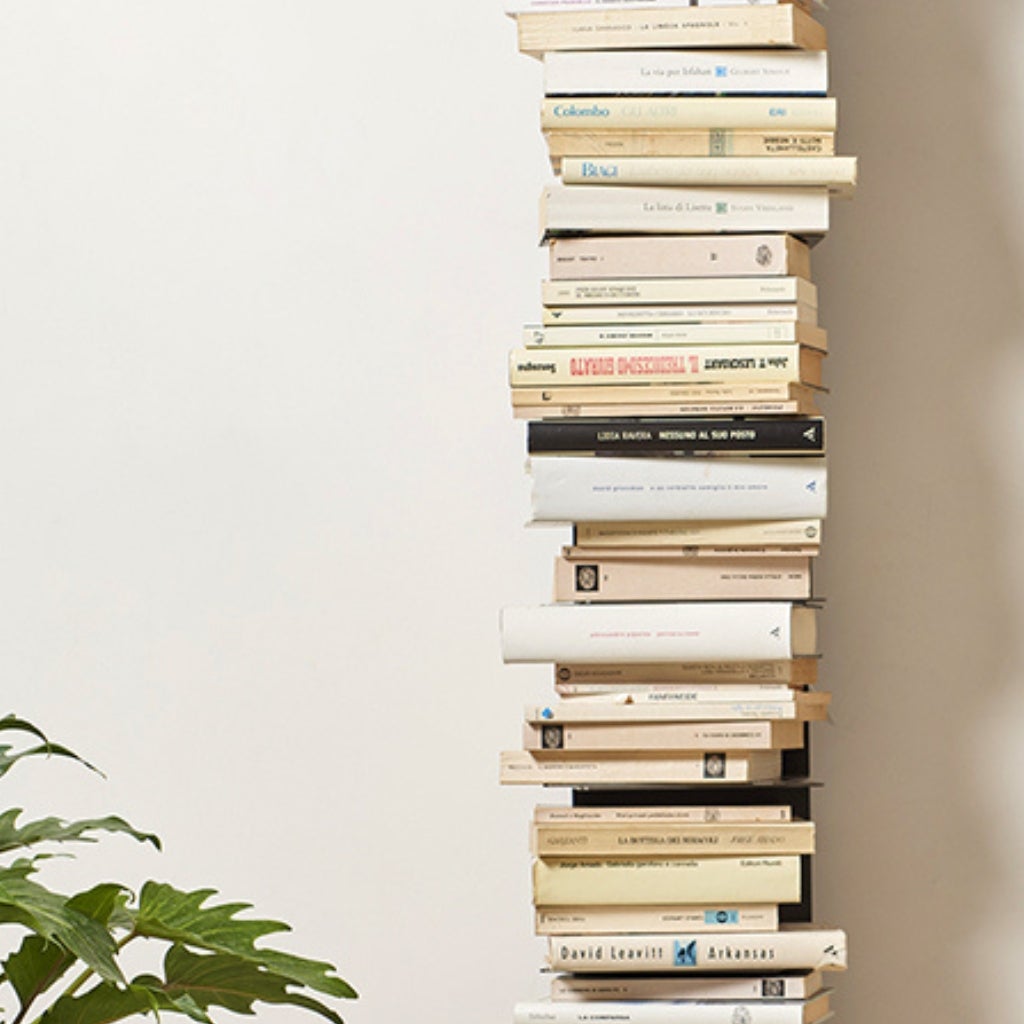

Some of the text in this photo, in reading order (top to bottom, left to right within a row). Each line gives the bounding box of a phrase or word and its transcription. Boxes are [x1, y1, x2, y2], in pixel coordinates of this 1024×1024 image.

[553, 104, 610, 117] Colombo
[658, 430, 757, 441] NESSUNO AL SUO POSTO
[560, 945, 663, 961] David Leavitt
[707, 945, 775, 961] Arkansas
